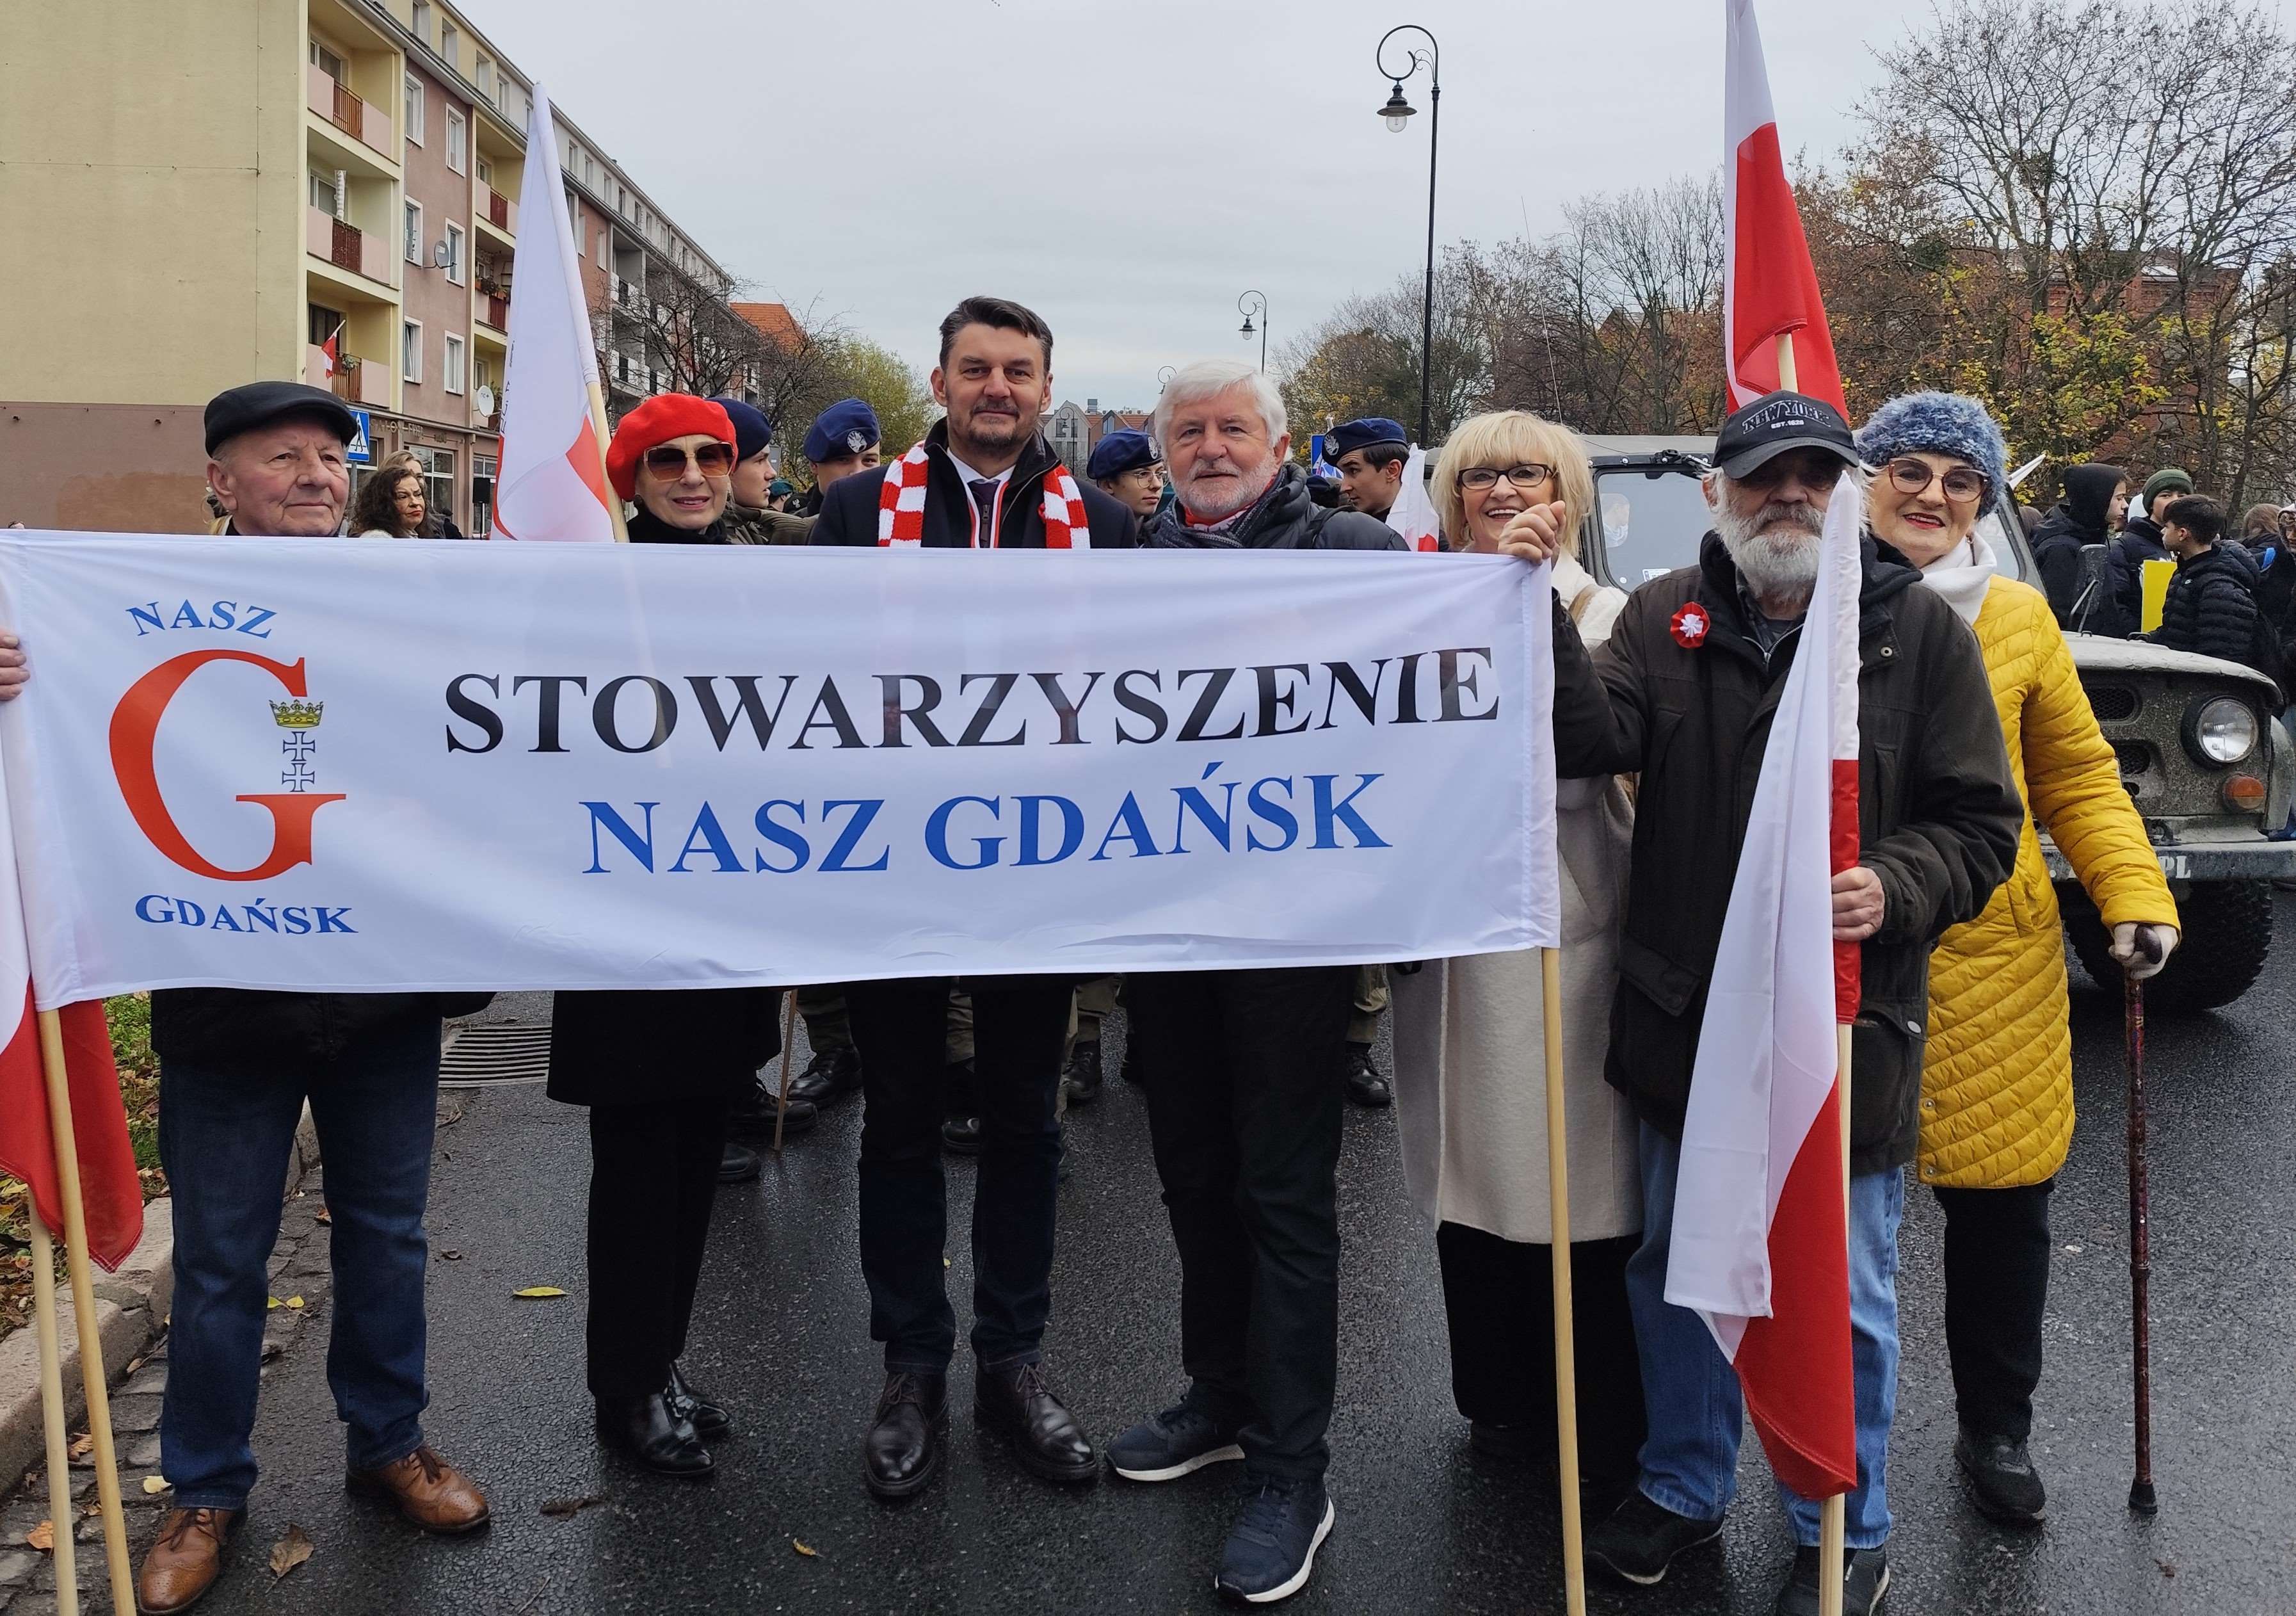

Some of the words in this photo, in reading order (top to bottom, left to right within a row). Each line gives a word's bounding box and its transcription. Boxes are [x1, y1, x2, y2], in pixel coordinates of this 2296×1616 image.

[1742, 401, 1783, 434] NEW
[1783, 400, 1831, 427] YORK
[125, 599, 277, 639] NASZ
[446, 647, 1500, 754] STOWARZYSZENIE
[108, 649, 347, 882] G
[579, 798, 890, 875] NASZ
[924, 761, 1393, 871] GDAŃSK
[134, 894, 358, 935] GDAŃSK
